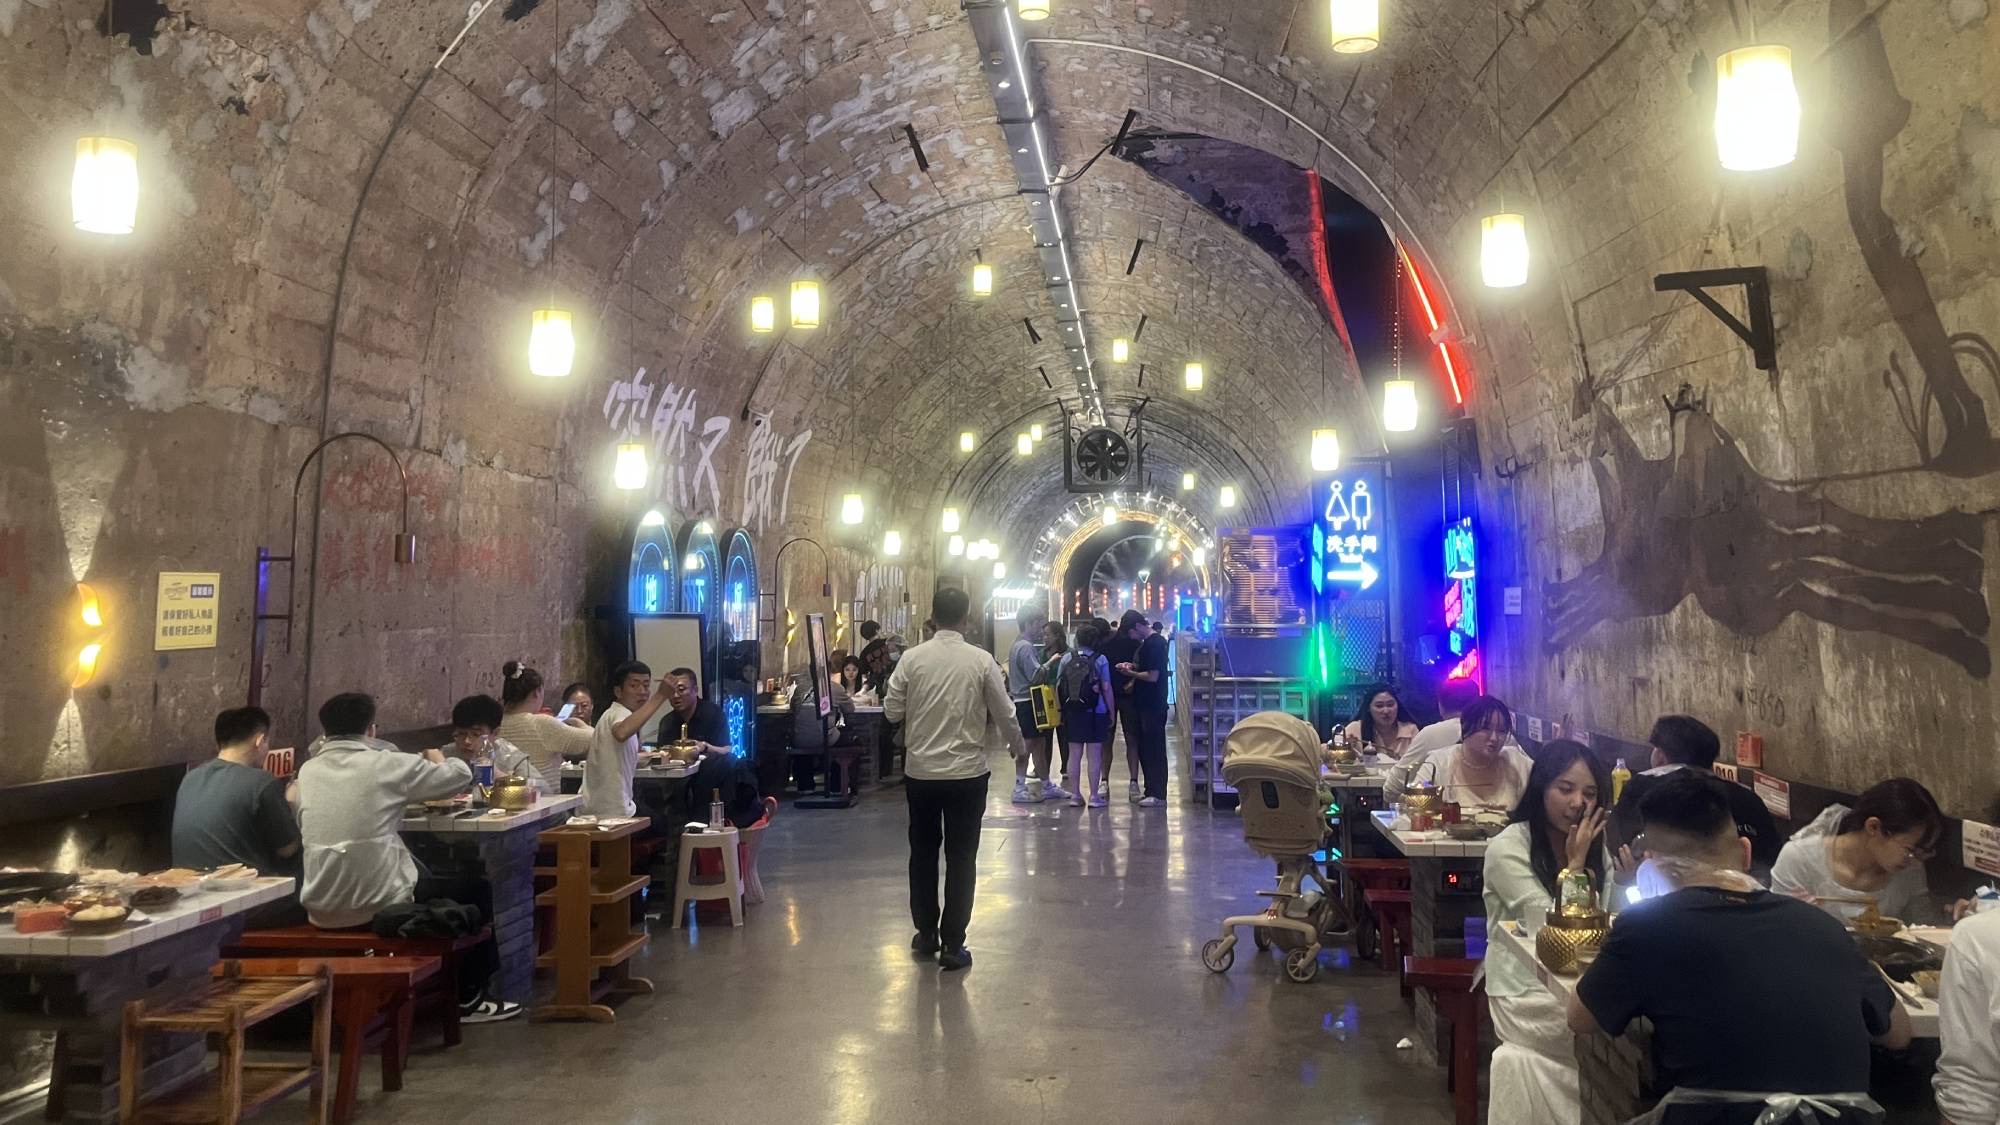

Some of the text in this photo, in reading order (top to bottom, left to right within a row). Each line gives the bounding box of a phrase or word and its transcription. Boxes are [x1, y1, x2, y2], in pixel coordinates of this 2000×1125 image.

[1326, 534, 1377, 553] 洗手间
[267, 750, 291, 776] 016
